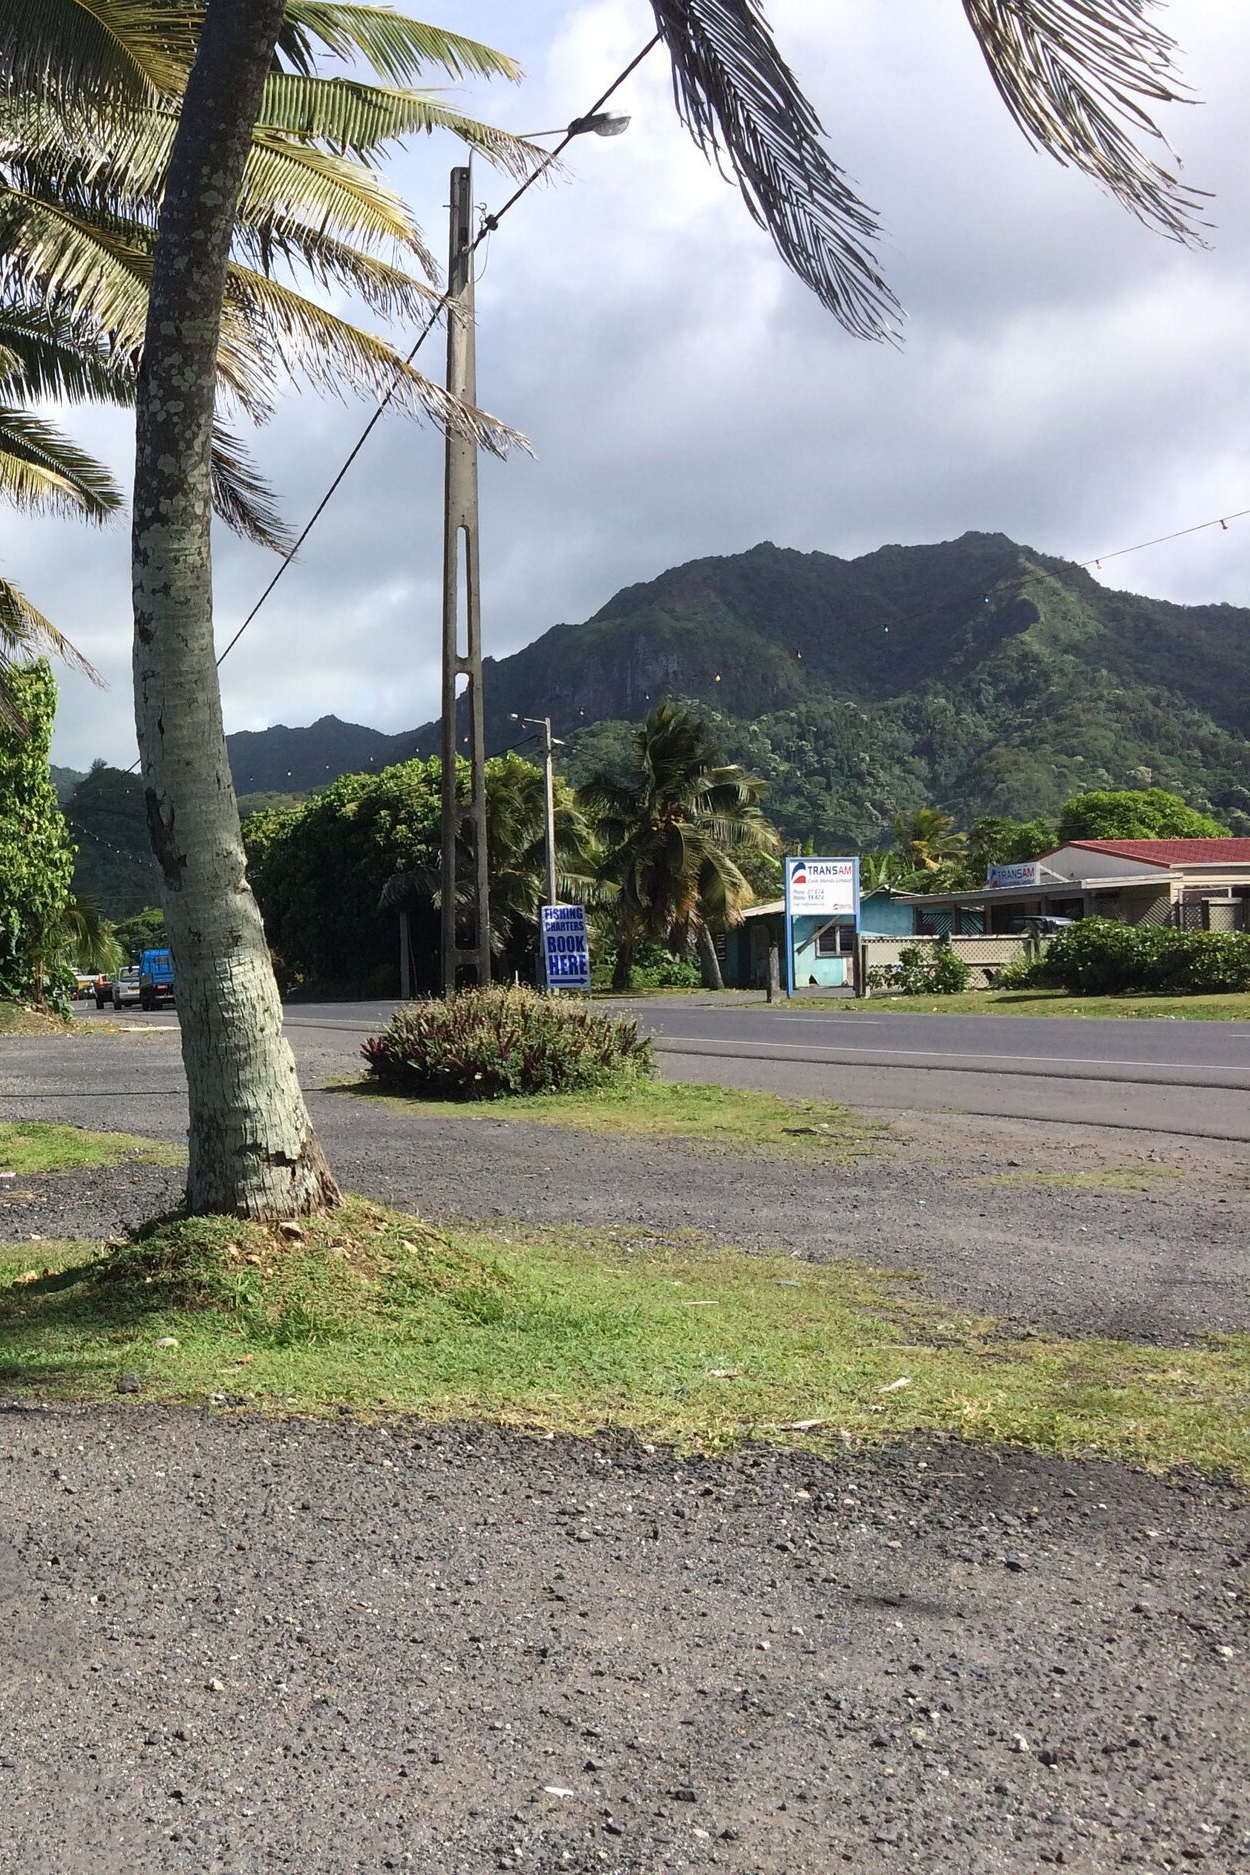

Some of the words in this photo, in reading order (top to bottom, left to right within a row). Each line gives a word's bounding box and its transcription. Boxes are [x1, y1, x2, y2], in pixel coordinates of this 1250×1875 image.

[807, 866, 852, 875] TRANSAM
[997, 867, 1034, 879] TRANSAM
[545, 908, 583, 919] FISHING
[546, 921, 584, 932] CHARTERS
[547, 936, 585, 953] BOOK
[549, 955, 587, 975] HERE
